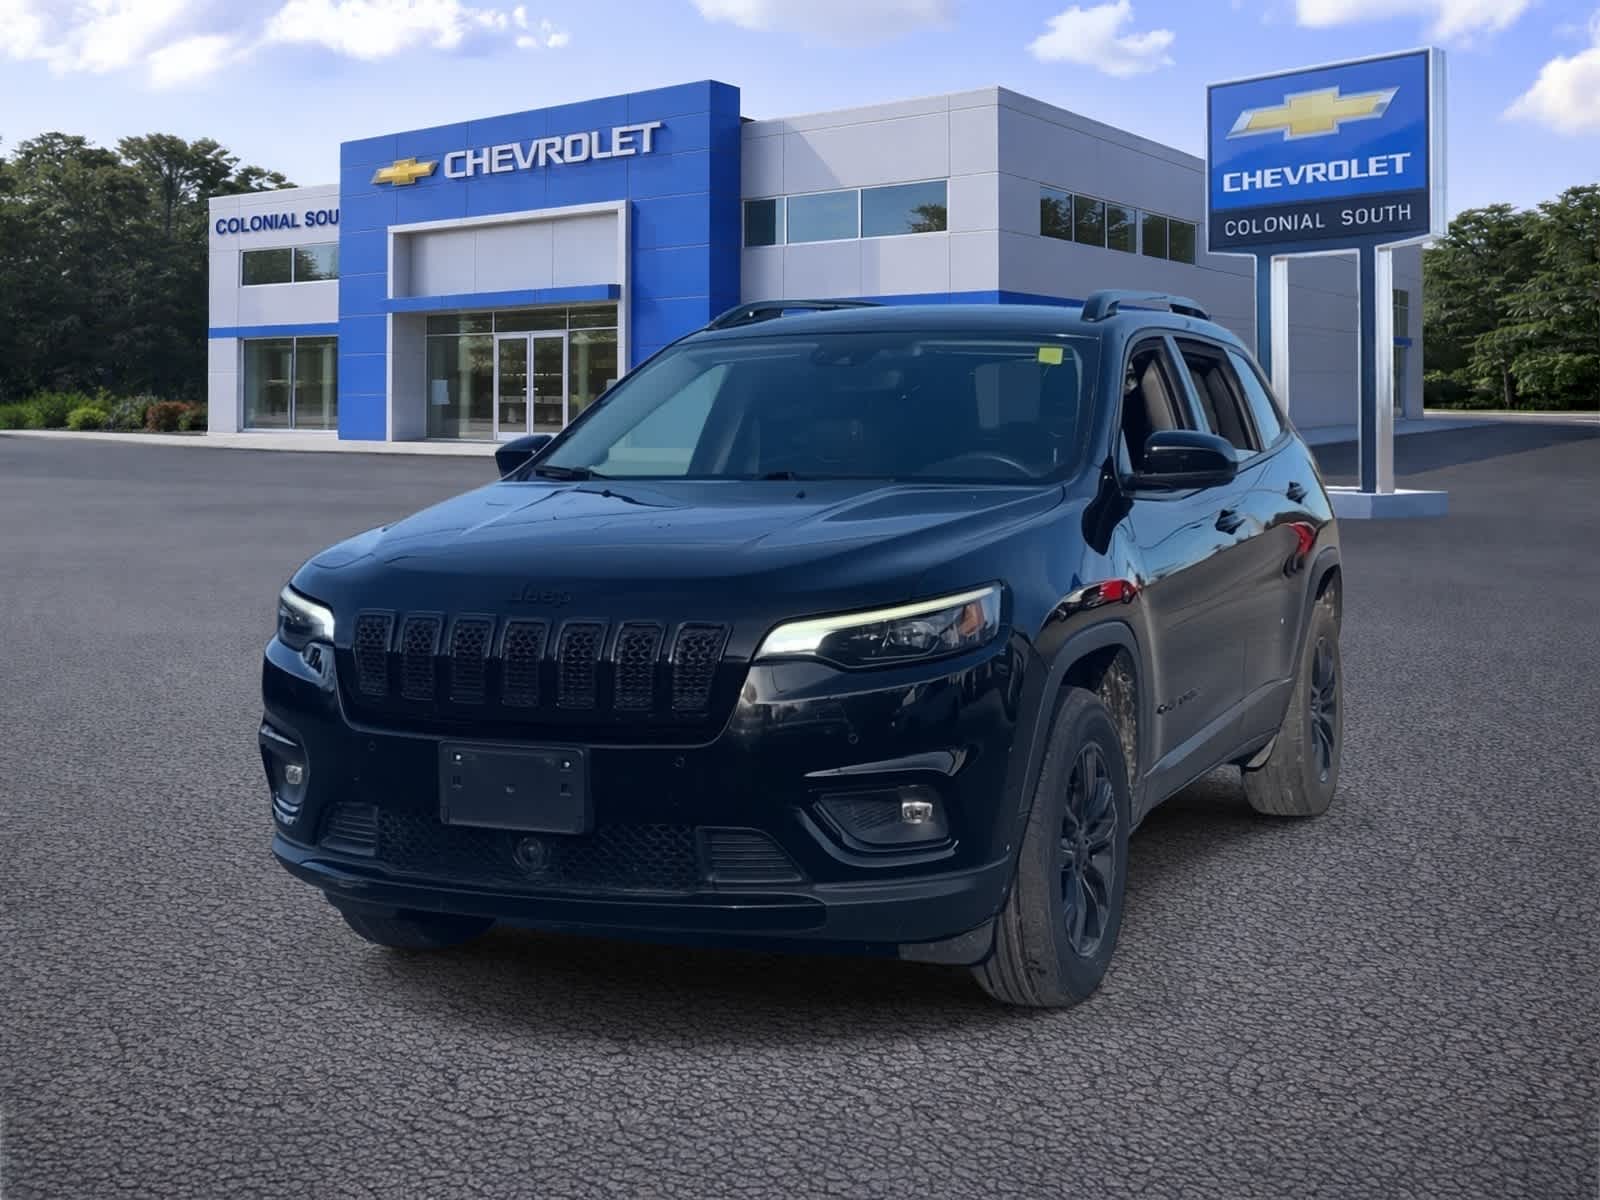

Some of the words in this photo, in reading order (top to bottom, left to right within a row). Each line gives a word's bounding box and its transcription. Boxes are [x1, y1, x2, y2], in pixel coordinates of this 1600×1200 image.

[444, 121, 662, 179] CHEVROLET
[1223, 152, 1411, 192] CHEVROLET
[215, 212, 301, 234] COLONIAL
[304, 208, 339, 228] SOU
[1225, 213, 1325, 236] COLONIAL
[1341, 204, 1411, 226] SOUTH
